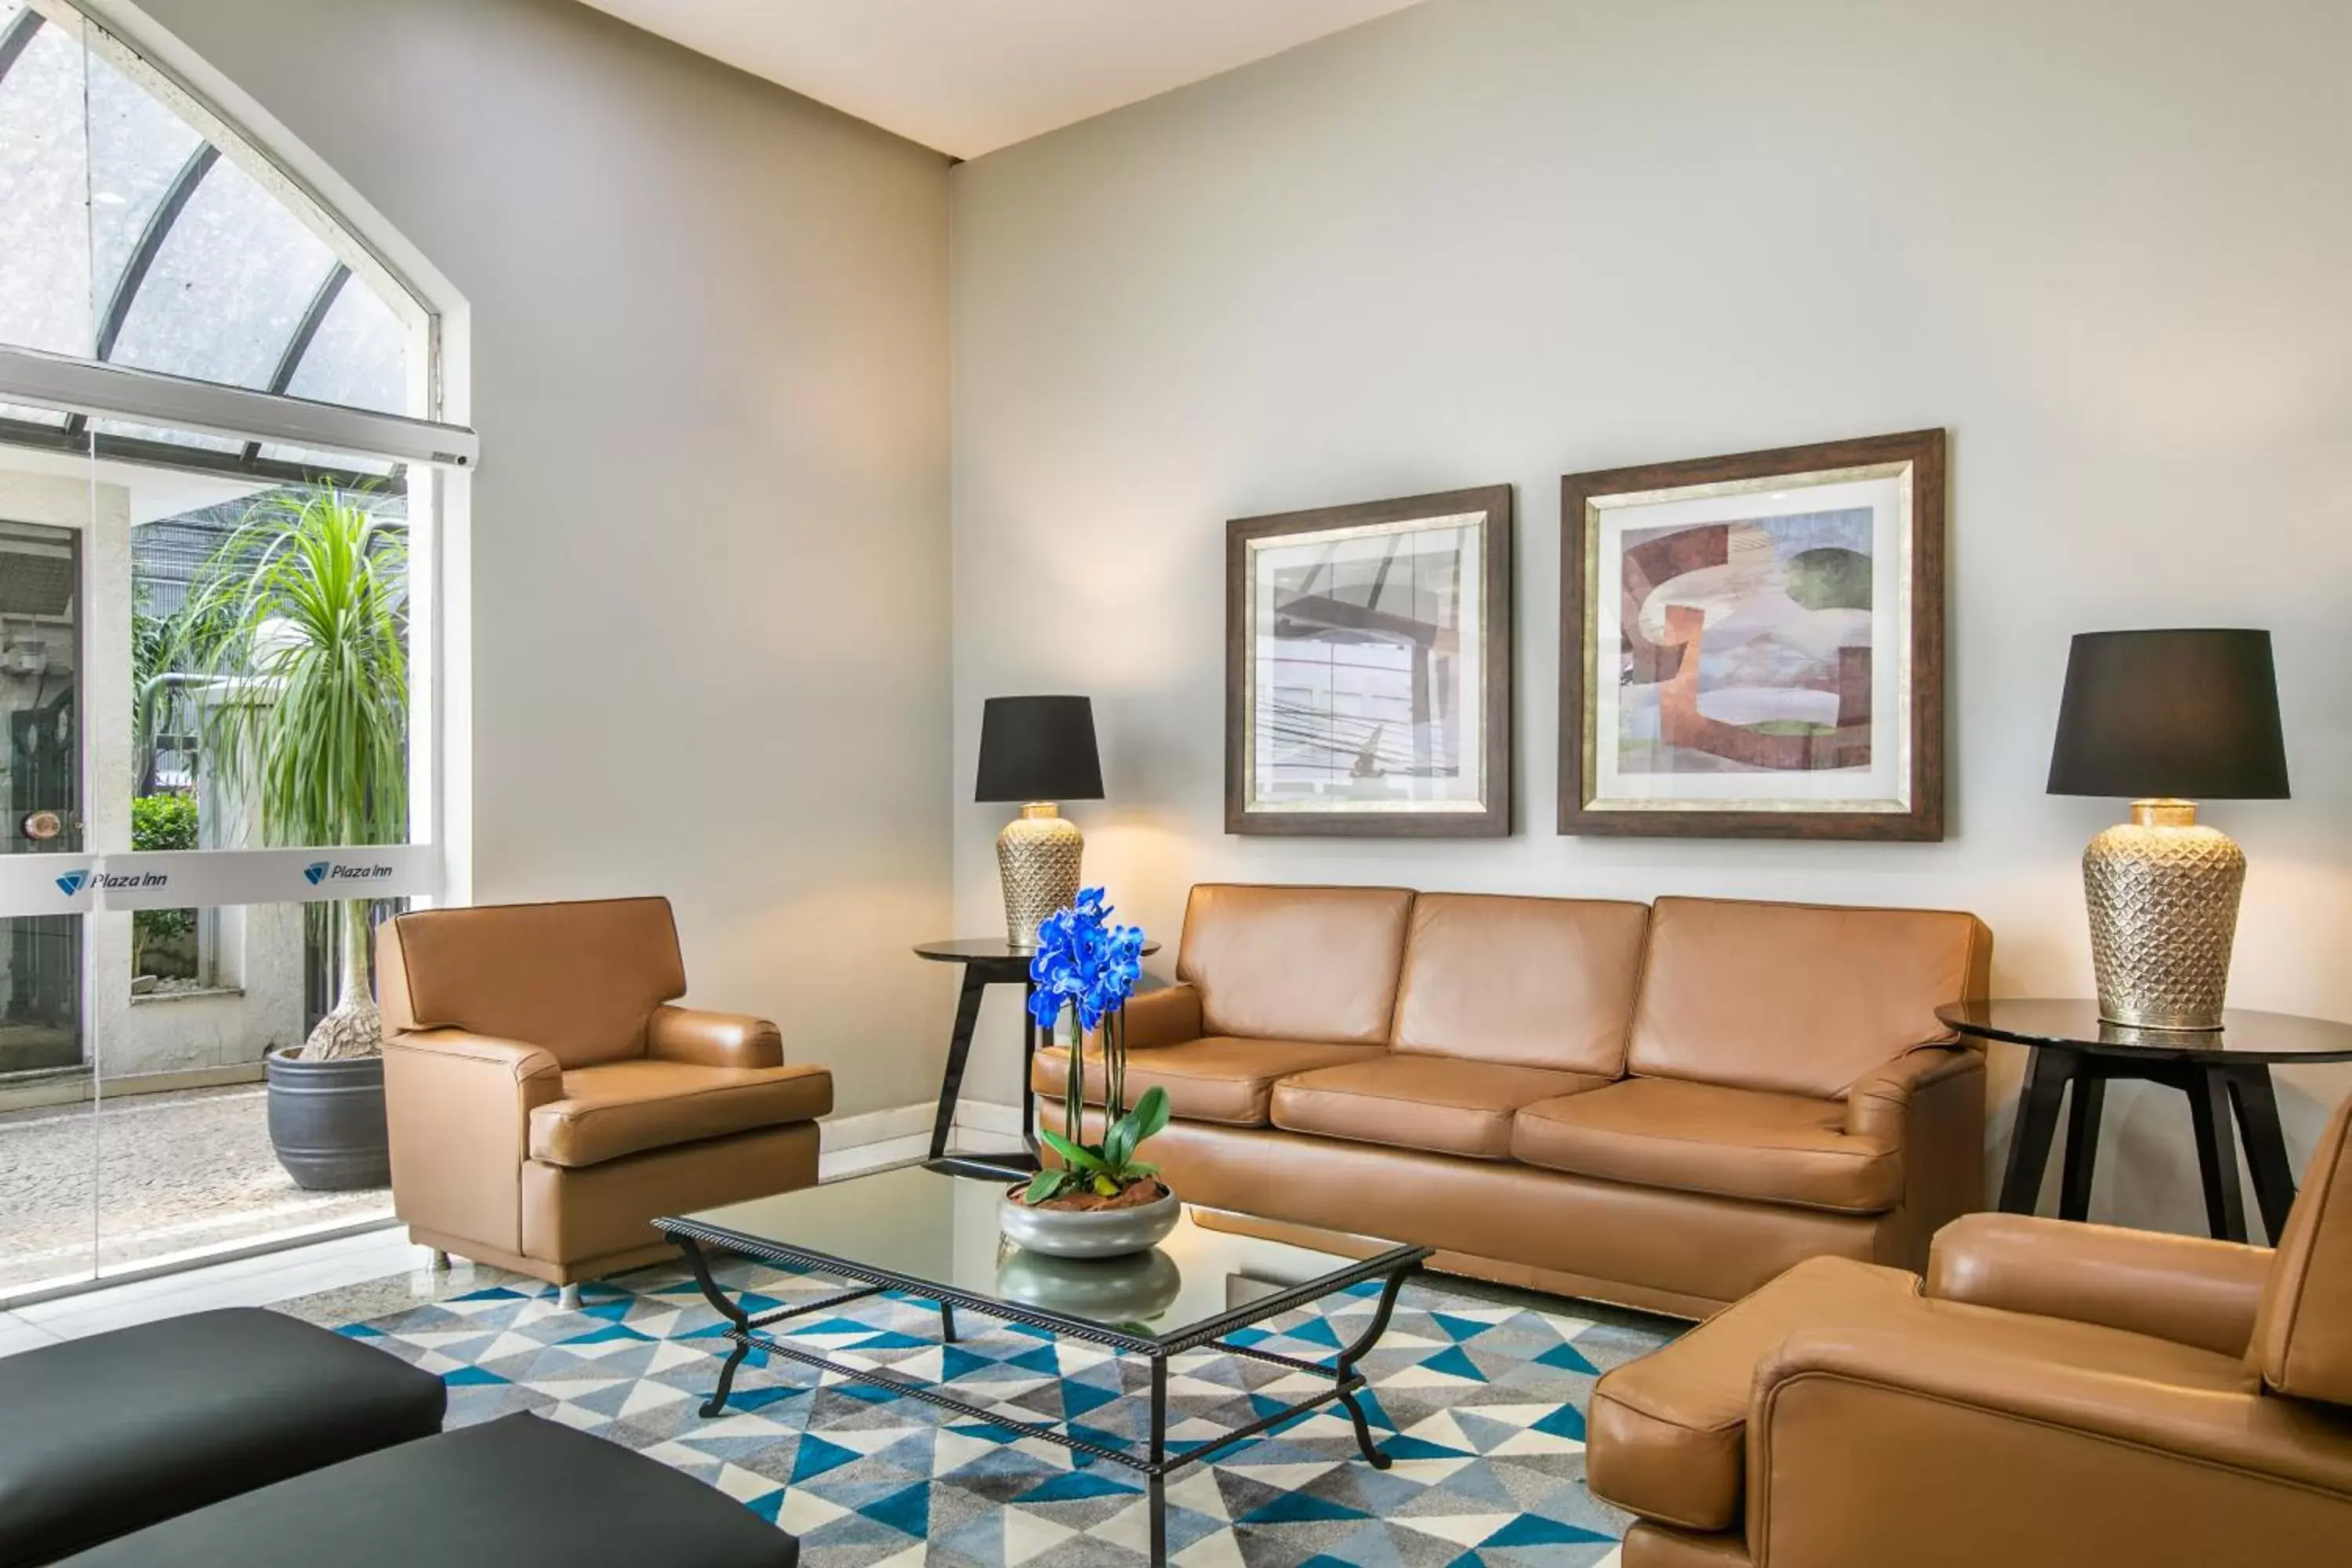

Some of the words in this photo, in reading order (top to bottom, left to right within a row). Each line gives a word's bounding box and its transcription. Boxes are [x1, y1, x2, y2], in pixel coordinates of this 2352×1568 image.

[331, 865, 371, 879] Plaza
[372, 864, 393, 877] Inn
[90, 873, 140, 888] Plaza
[142, 872, 168, 886] Inn
